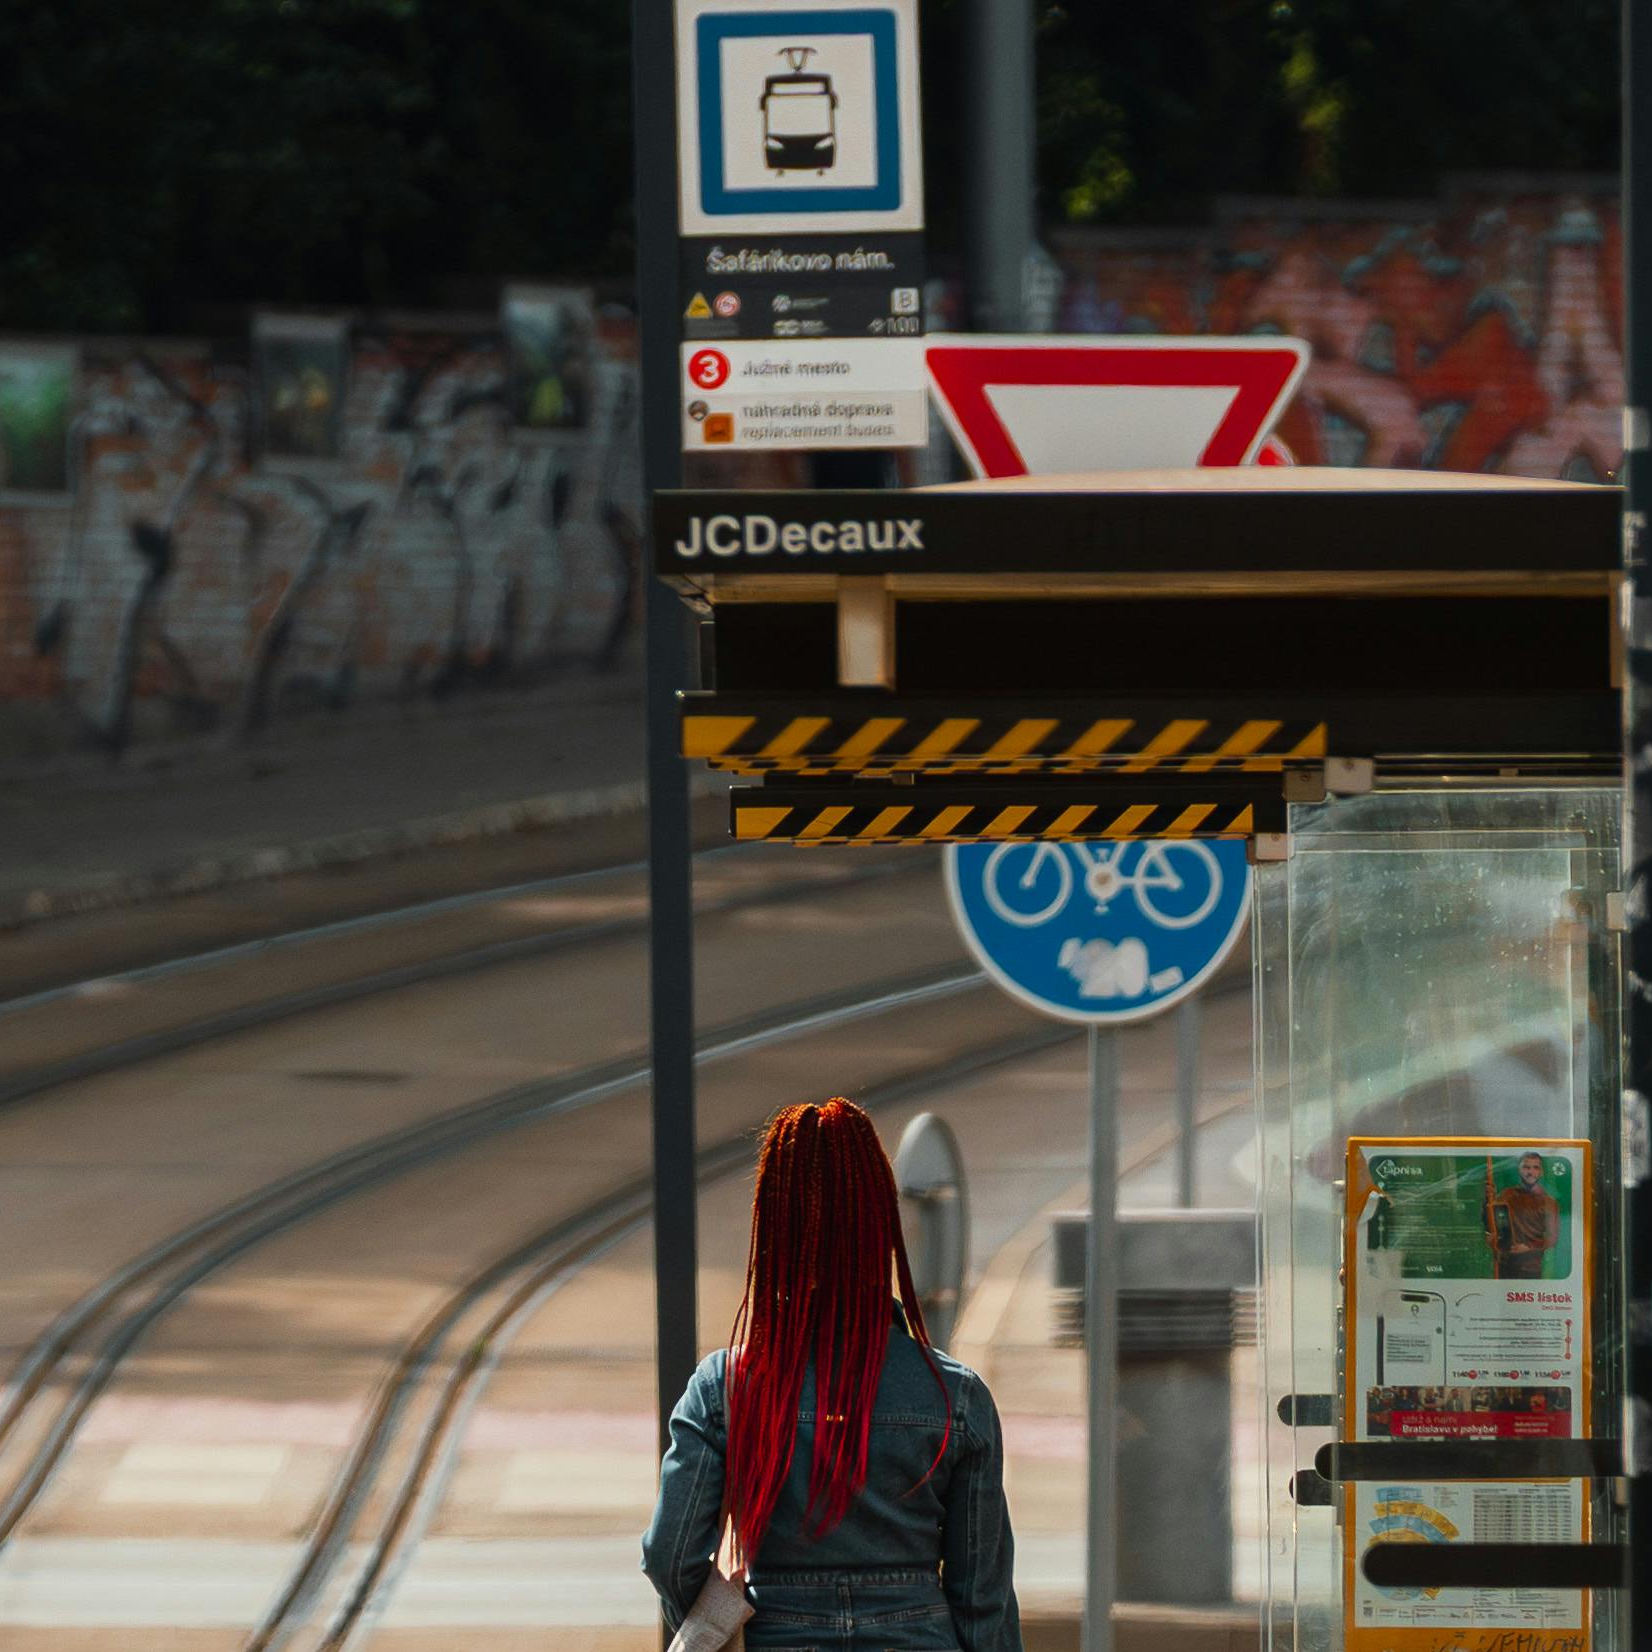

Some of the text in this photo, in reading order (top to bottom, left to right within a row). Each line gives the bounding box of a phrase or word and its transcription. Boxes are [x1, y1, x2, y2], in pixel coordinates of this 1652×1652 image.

[706, 245, 895, 273] Šafárikovo nám.
[698, 355, 719, 383] 3
[675, 514, 925, 557] JCDecaux
[1506, 1291, 1535, 1303] SMS
